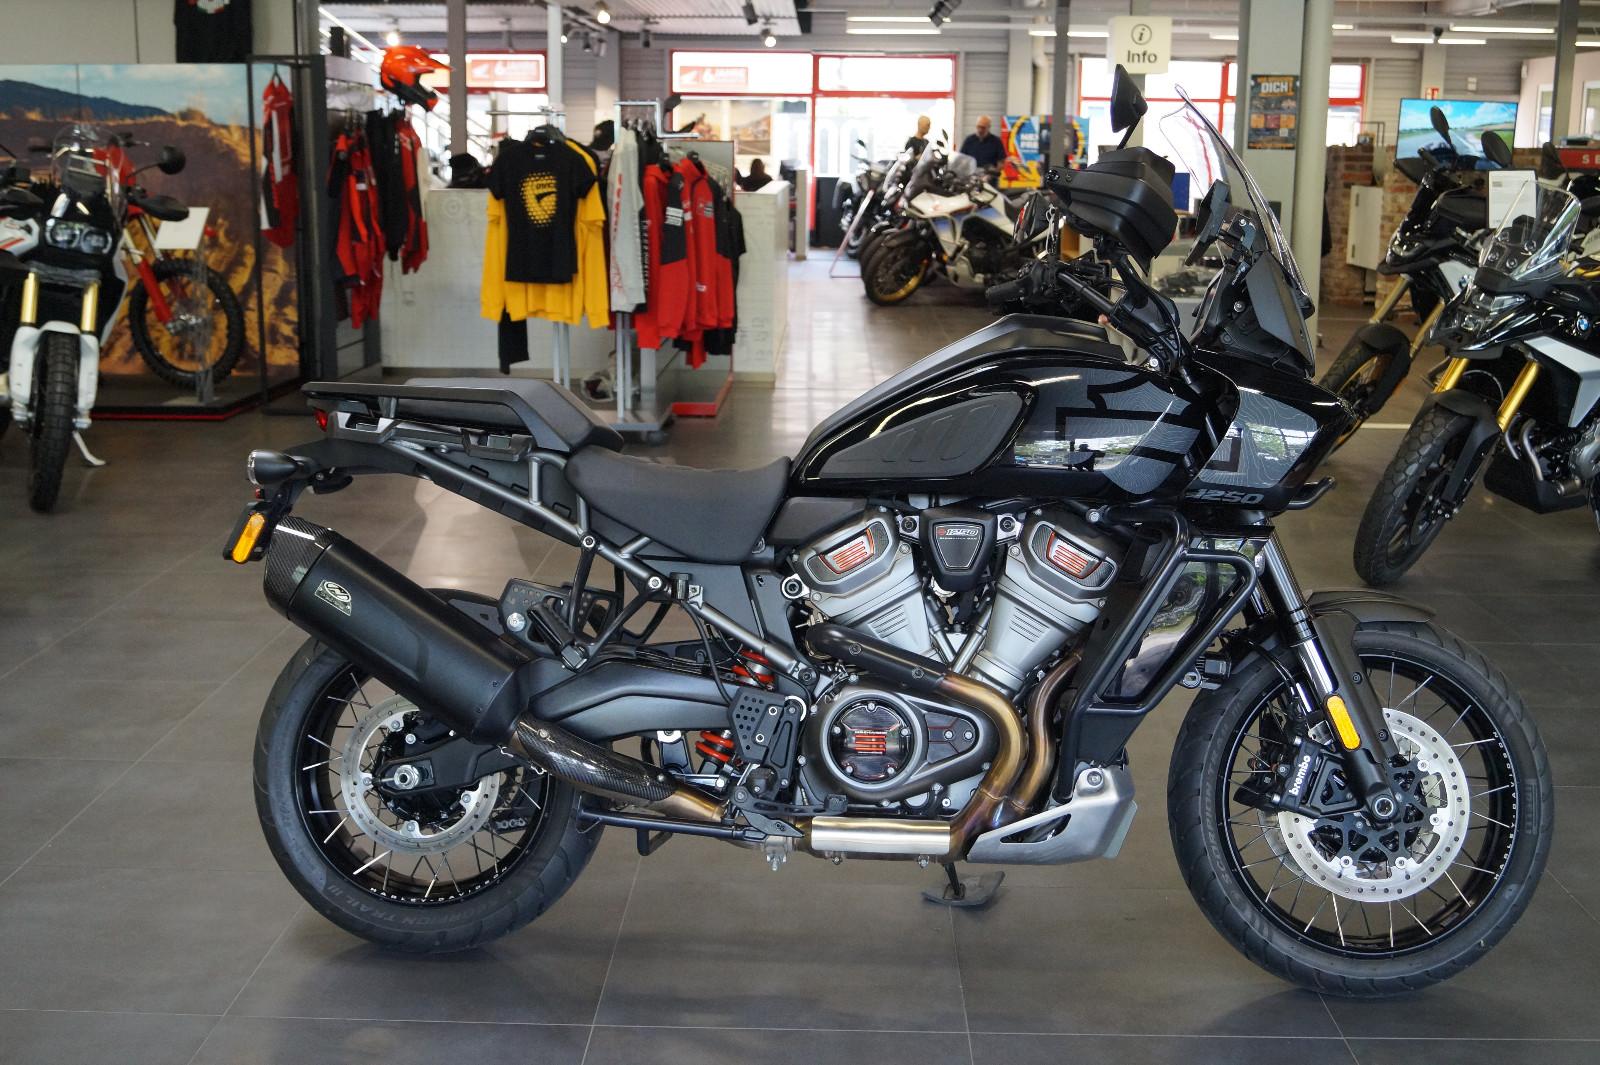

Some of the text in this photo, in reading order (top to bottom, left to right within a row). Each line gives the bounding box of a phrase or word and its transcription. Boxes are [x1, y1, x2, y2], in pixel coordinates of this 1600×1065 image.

[1127, 50, 1158, 63] Info
[1185, 489, 1265, 504] 1250
[1289, 755, 1311, 796] brembo
[1494, 732, 1515, 880] HARLEY-DAVIDSON
[1205, 782, 1232, 884] SCORPION
